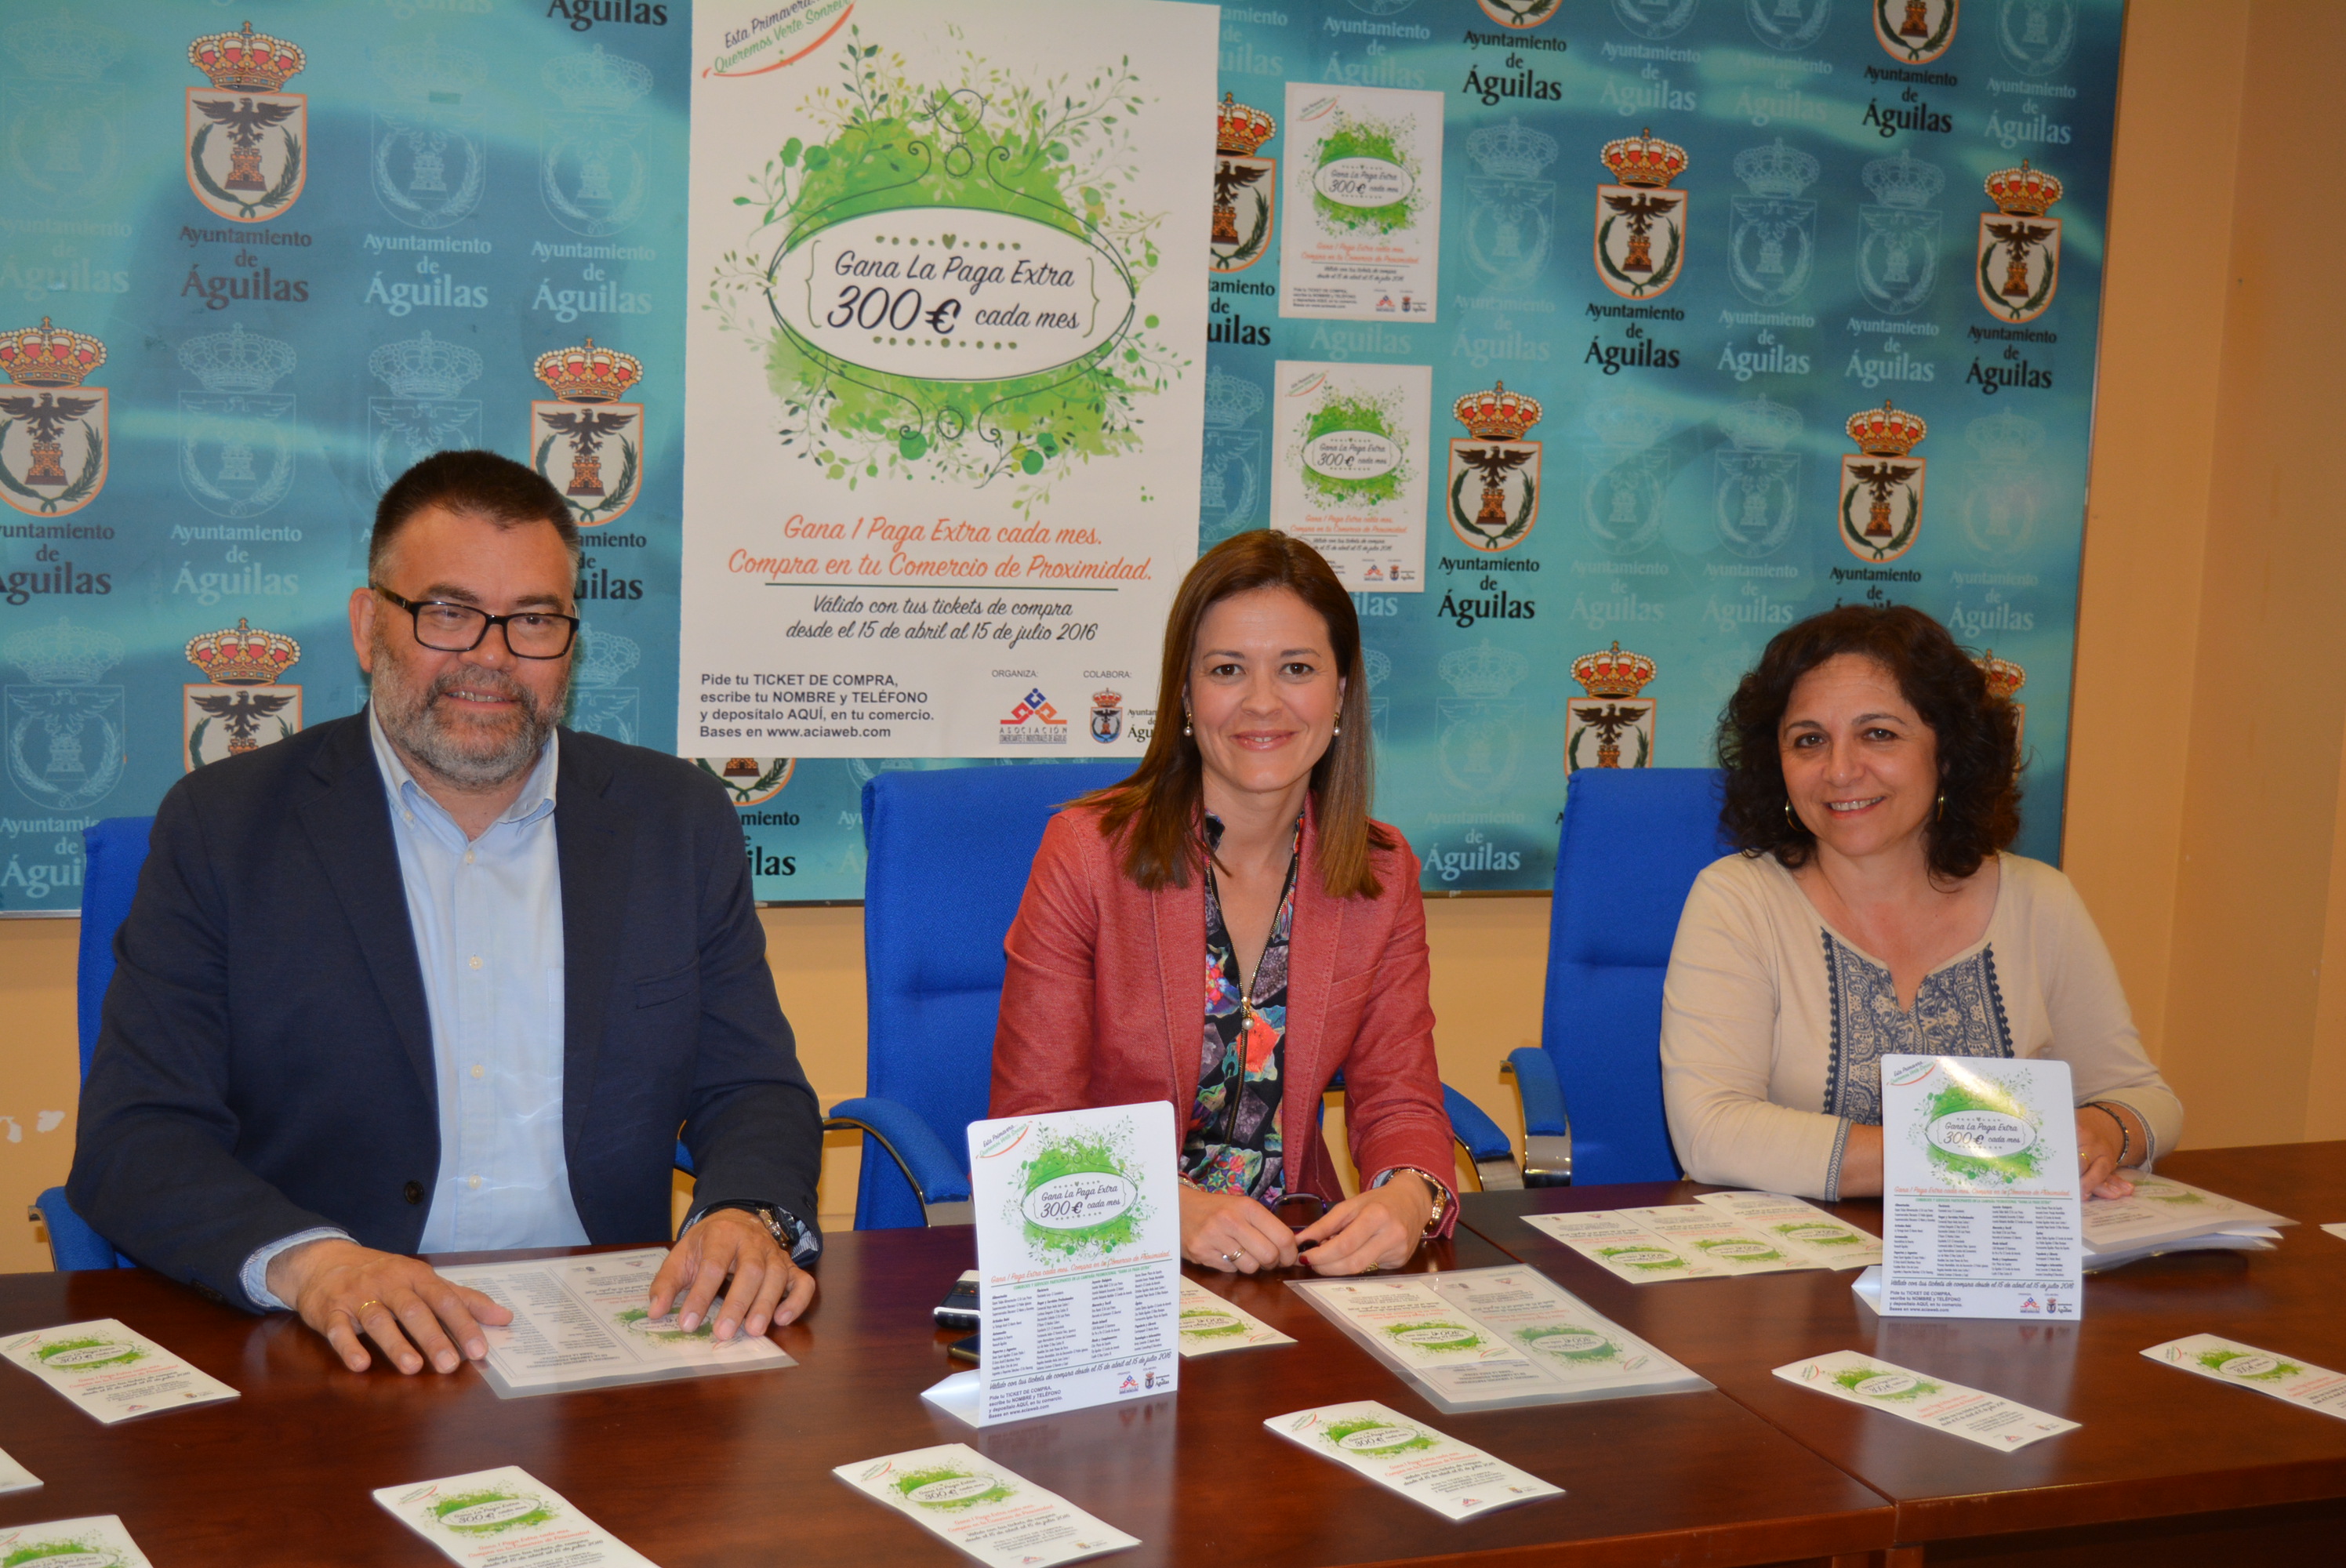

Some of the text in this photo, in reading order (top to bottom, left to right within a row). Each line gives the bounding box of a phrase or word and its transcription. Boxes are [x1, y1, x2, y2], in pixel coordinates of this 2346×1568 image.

[714, 36, 772, 73] Queremos
[773, 19, 804, 41] Verte
[724, 28, 750, 49] Esta
[1463, 30, 1567, 52] Ayuntamiento
[1505, 53, 1523, 68] de
[1462, 64, 1562, 106] Águilas
[1864, 66, 1958, 87] Ayuntamiento
[1901, 87, 1917, 103] de
[1986, 78, 2077, 99] Ayuntamiento
[2023, 99, 2037, 115] de
[1862, 98, 1952, 138] Águilas
[1985, 110, 2072, 150] Águilas
[179, 226, 312, 248] Ayuntamiento
[363, 234, 492, 254] Ayuntamiento
[234, 249, 258, 267] de
[531, 241, 656, 261] Ayuntamiento
[416, 256, 439, 274] de
[583, 263, 605, 281] de
[835, 250, 1075, 296] Gana La Paga Extra
[180, 263, 310, 310] Águilas
[365, 270, 488, 317] Águilas
[532, 278, 652, 323] Águilas
[1211, 297, 1229, 314] de
[975, 303, 1031, 328] cada
[1035, 312, 1080, 330] mes
[1585, 303, 1685, 321] Ayuntamiento
[1718, 310, 1815, 328] Ayuntamiento
[1208, 314, 1271, 346] uilas
[1625, 323, 1643, 339] de
[1846, 318, 1940, 336] Ayuntamiento
[1966, 325, 2057, 344] Ayuntamiento
[1757, 329, 1775, 345] de
[1884, 337, 1901, 353] de
[1584, 336, 1680, 376] Águilas
[1717, 342, 1810, 382] Águilas
[2003, 345, 2019, 361] de
[1845, 349, 1935, 388] Águilas
[1966, 357, 2053, 394] Águilas
[170, 524, 303, 545] Ayuntamiento
[784, 514, 1102, 553] Gana 1 Paga Extra cada mes.
[35, 544, 60, 562] de
[226, 546, 249, 563] de
[728, 549, 1152, 580] Compra en tu Comercio de Proximidad.
[1438, 557, 1540, 575] Ayuntamiento
[172, 561, 300, 605] Águilas
[1480, 575, 1498, 590] de
[1829, 567, 1921, 584] Ayuntamiento
[1866, 586, 1882, 600] de
[814, 594, 1073, 619] Válido con tus tickets de compra
[1437, 589, 1535, 628] Águilas
[786, 620, 1099, 649] desde el 15 de abril al 15 de julio 2016
[701, 674, 899, 688] Pide tu TICKET DE COMPRA,
[700, 689, 928, 706] escribe tu NOMBRE y TELÉFONO
[700, 710, 708, 722] y
[787, 706, 826, 721] AQUÍ,
[830, 711, 847, 720] en
[851, 710, 864, 720] tu
[869, 710, 934, 720] comercio.
[700, 726, 891, 737] Bases en www.aciaweb.com
[1465, 829, 1484, 844] de
[1422, 843, 1520, 881] Águilas
[1945, 1121, 1966, 1130] Gana
[1977, 1123, 1996, 1134] Paga
[1041, 1192, 1062, 1201] Gana
[1076, 1188, 1095, 1200] Paga
[1098, 1185, 1118, 1194] Extra
[1088, 1200, 1105, 1209] cada
